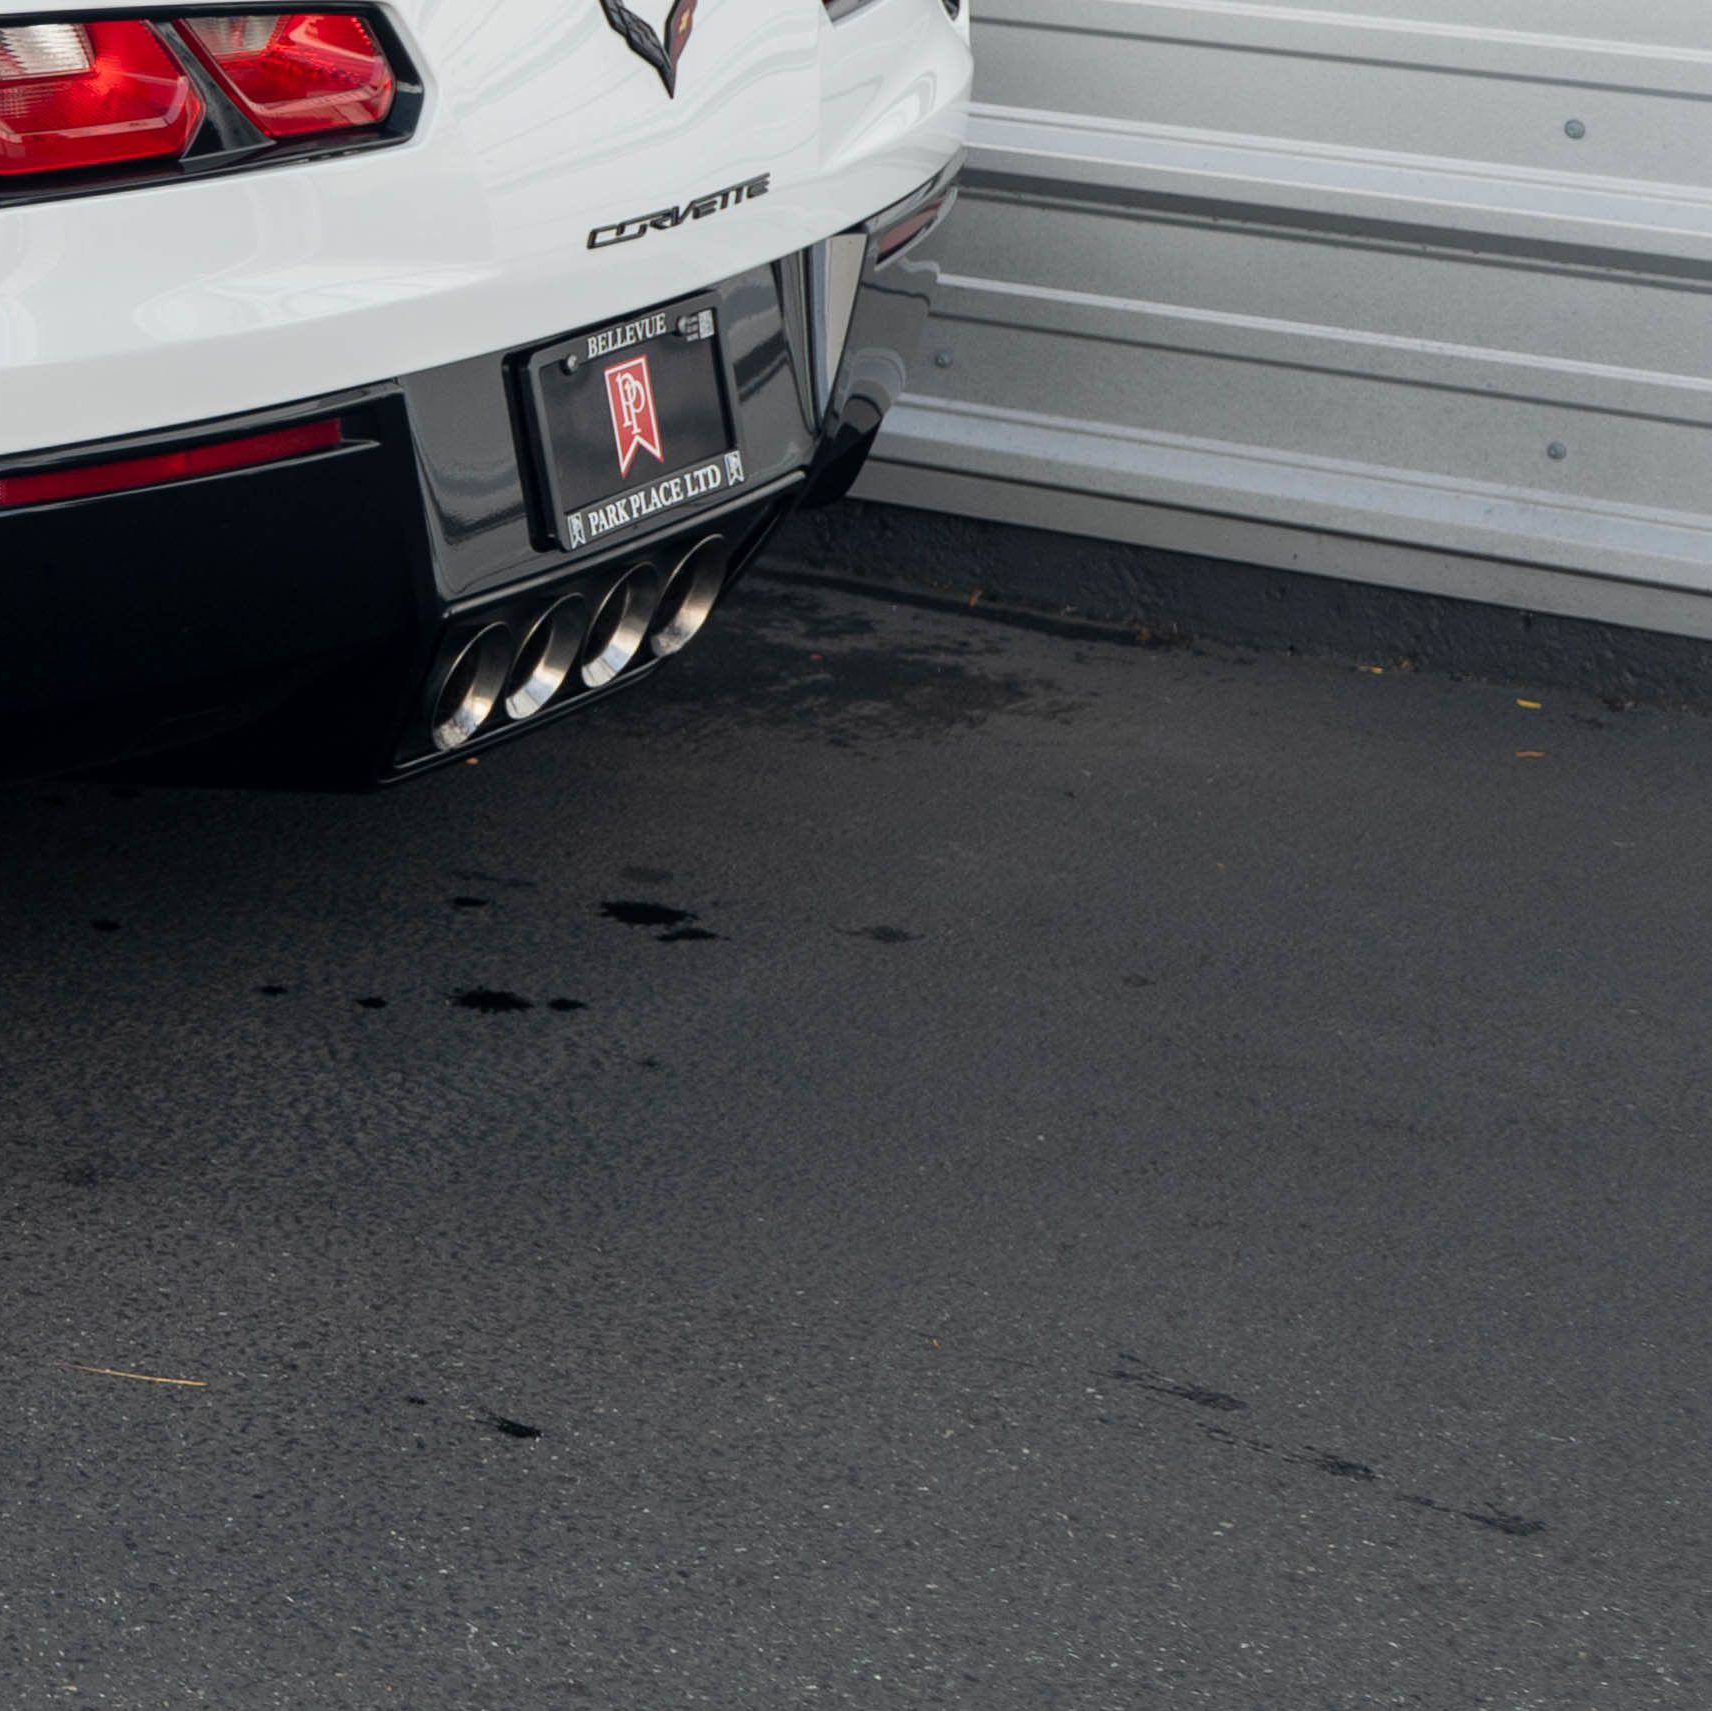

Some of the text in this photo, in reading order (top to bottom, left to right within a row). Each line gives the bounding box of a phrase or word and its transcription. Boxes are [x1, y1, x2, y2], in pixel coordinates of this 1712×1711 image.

[587, 172, 770, 249] CORVETTE
[587, 312, 667, 359] BELLEVUE
[588, 464, 721, 536] PARK PLACE LTD
